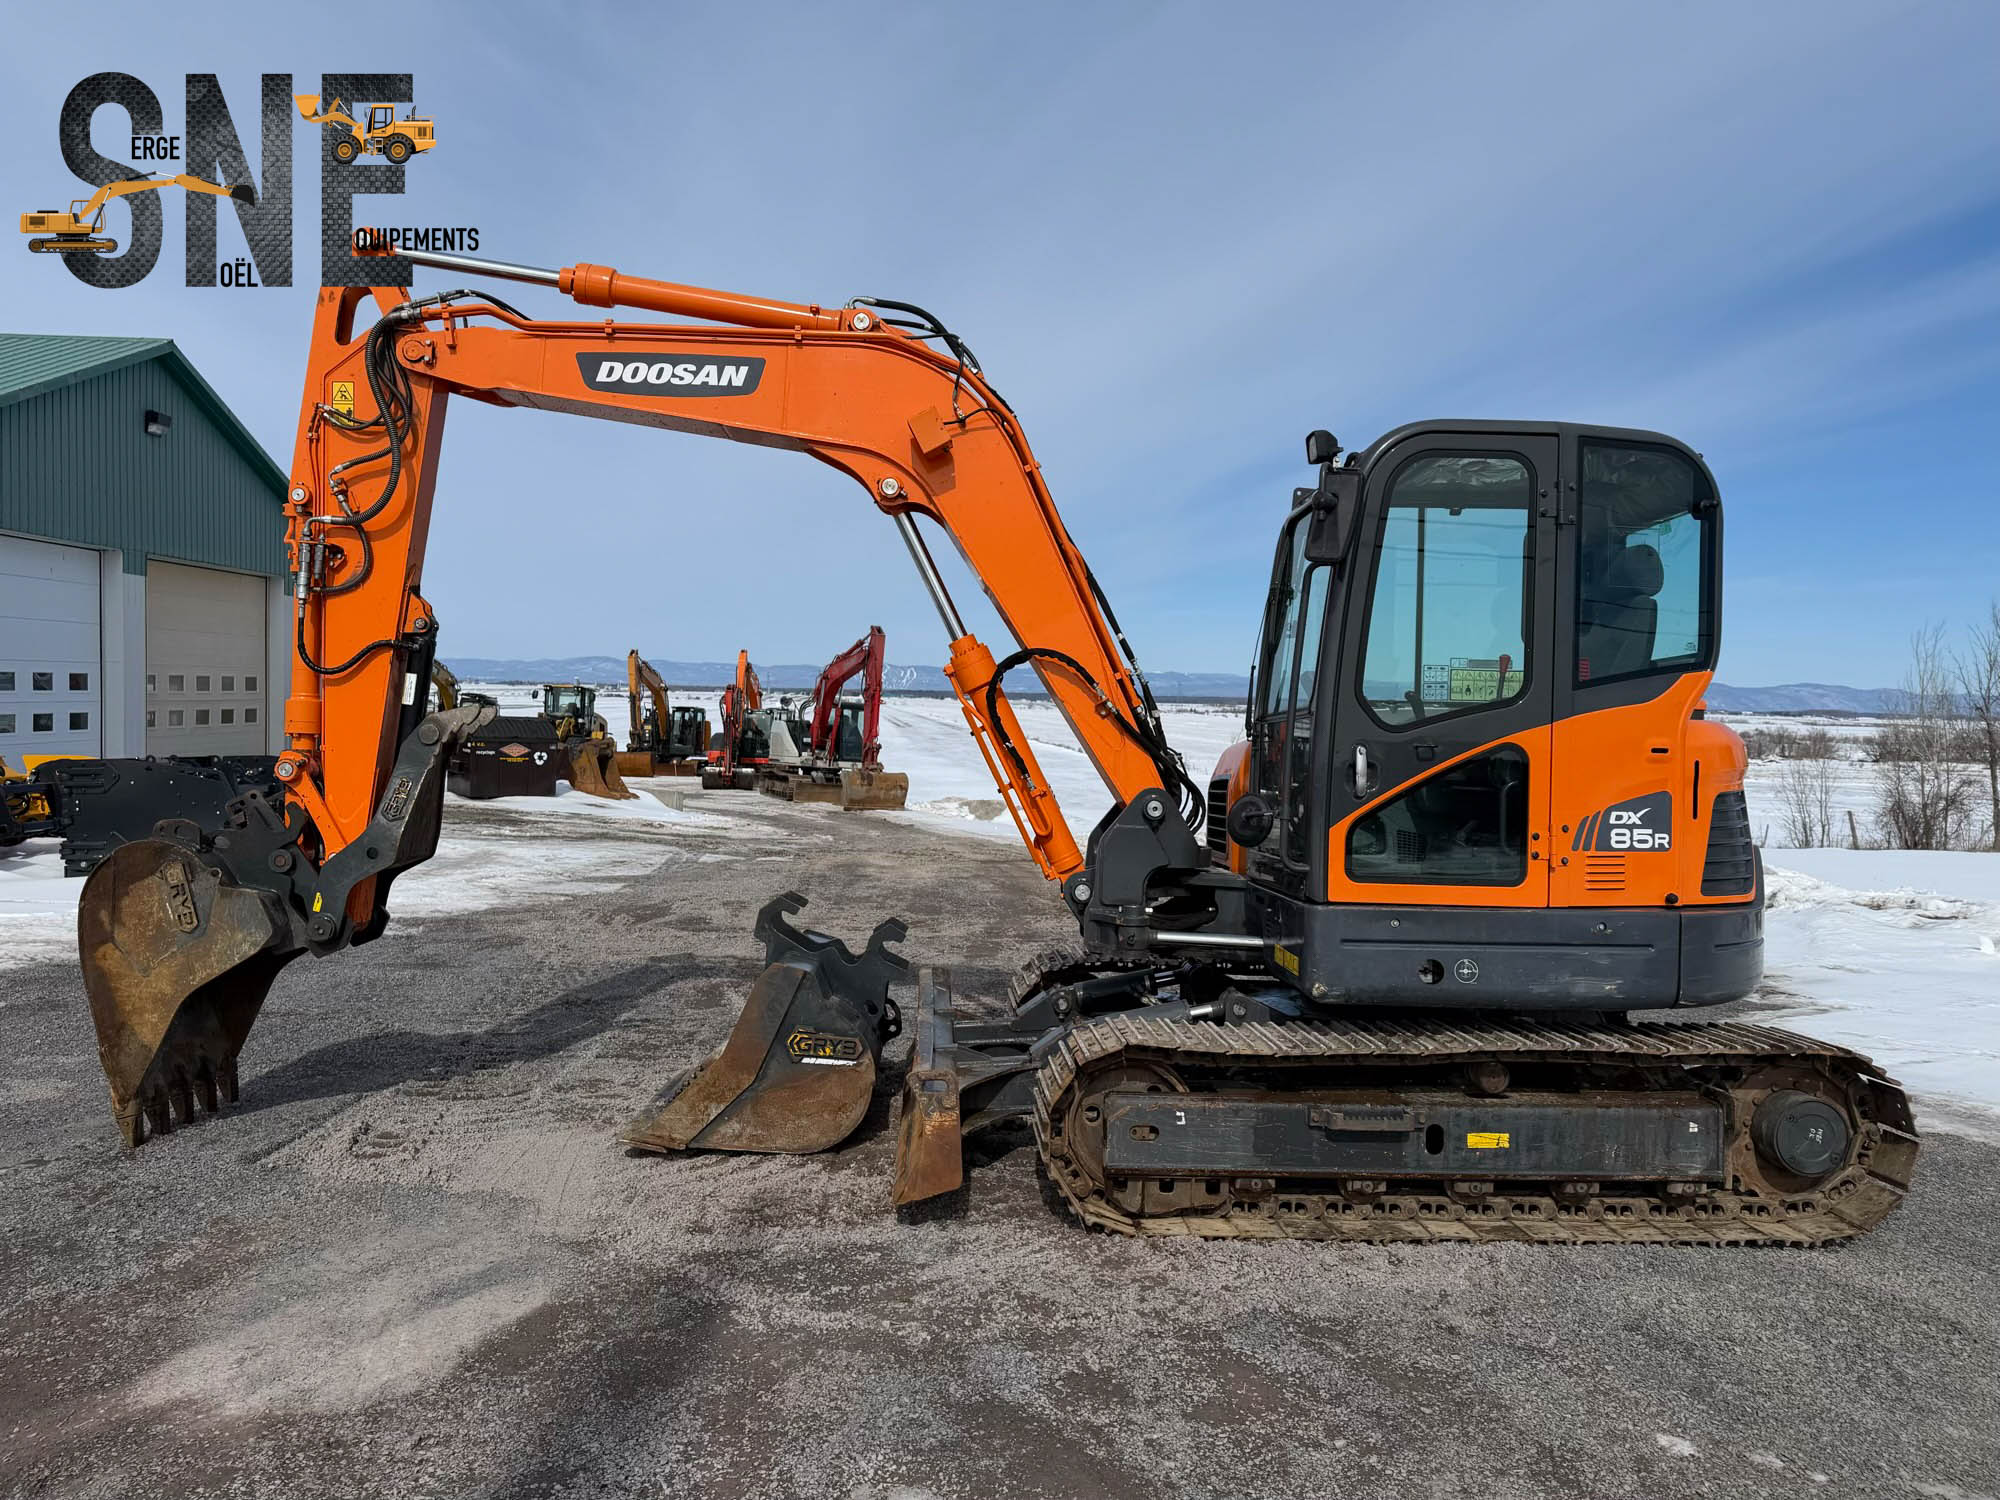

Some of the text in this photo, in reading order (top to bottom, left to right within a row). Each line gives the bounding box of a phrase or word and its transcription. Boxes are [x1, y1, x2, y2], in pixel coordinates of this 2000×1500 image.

[595, 361, 749, 387] DOOSAN
[1609, 808, 1652, 824] DX
[1610, 828, 1670, 849] 85R
